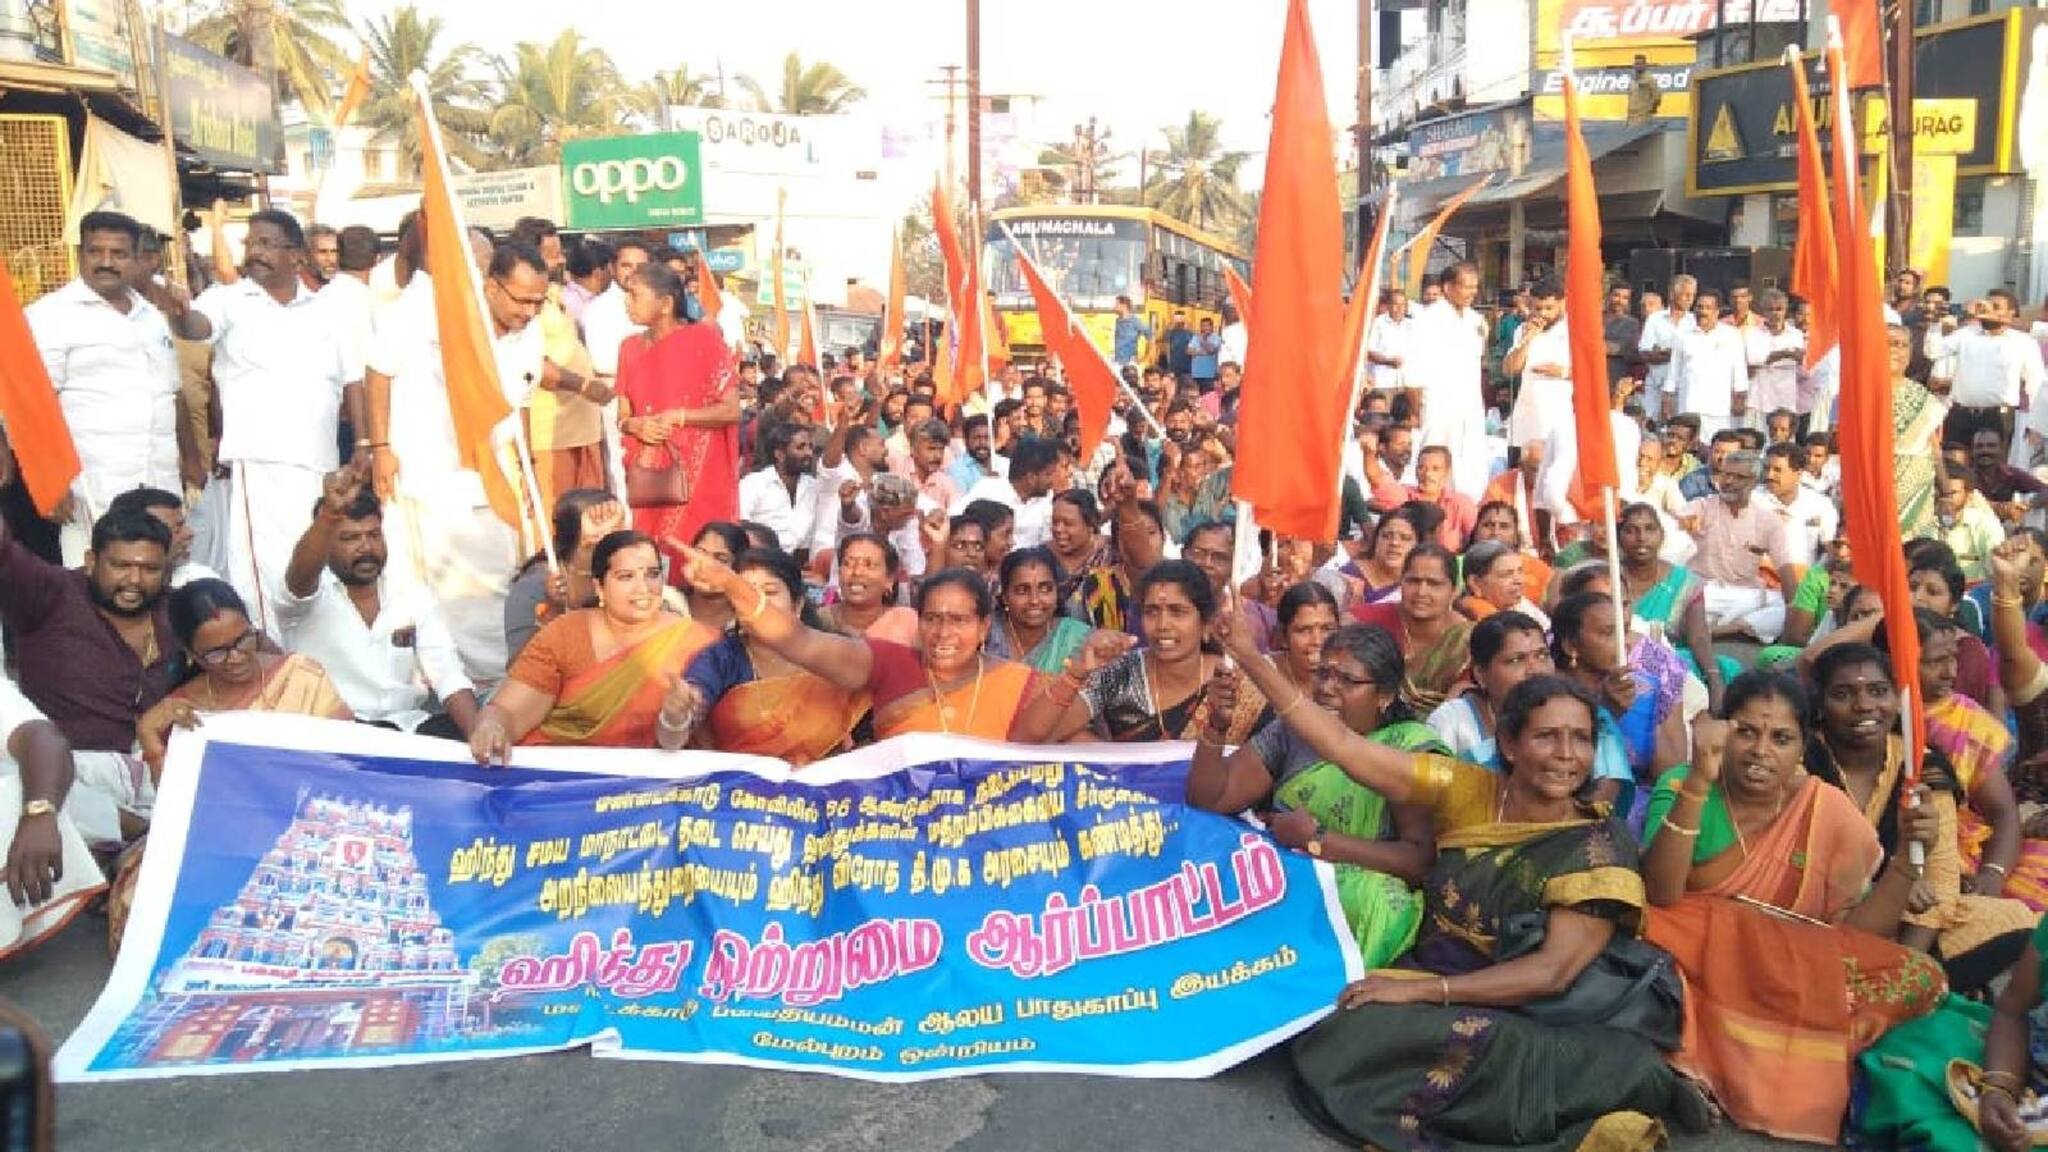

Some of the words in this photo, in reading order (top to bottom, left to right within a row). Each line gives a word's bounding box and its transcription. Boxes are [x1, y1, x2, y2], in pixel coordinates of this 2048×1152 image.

[1543, 68, 1689, 94] Egineed
[706, 116, 801, 147] SAROJA
[573, 156, 687, 204] oppo
[1011, 219, 1115, 235] ARUNACHALA
[448, 836, 516, 887] ஹிந்து
[526, 837, 570, 868] சமய
[580, 818, 670, 863] மாநாட்டை
[676, 815, 722, 853] தடை
[731, 816, 795, 870] செய்து
[833, 851, 900, 893] விரோத
[983, 828, 1071, 888] அரசையும்
[490, 926, 694, 1003] ஹிந்து
[702, 918, 943, 1006] ஒற்றுமை
[966, 832, 1288, 980] ஆர்ப்பாட்டம்
[917, 998, 1006, 1037] ஆலய
[1016, 986, 1159, 1023] பாதுகாப்பு
[1169, 943, 1298, 1000] இயக்கம்
